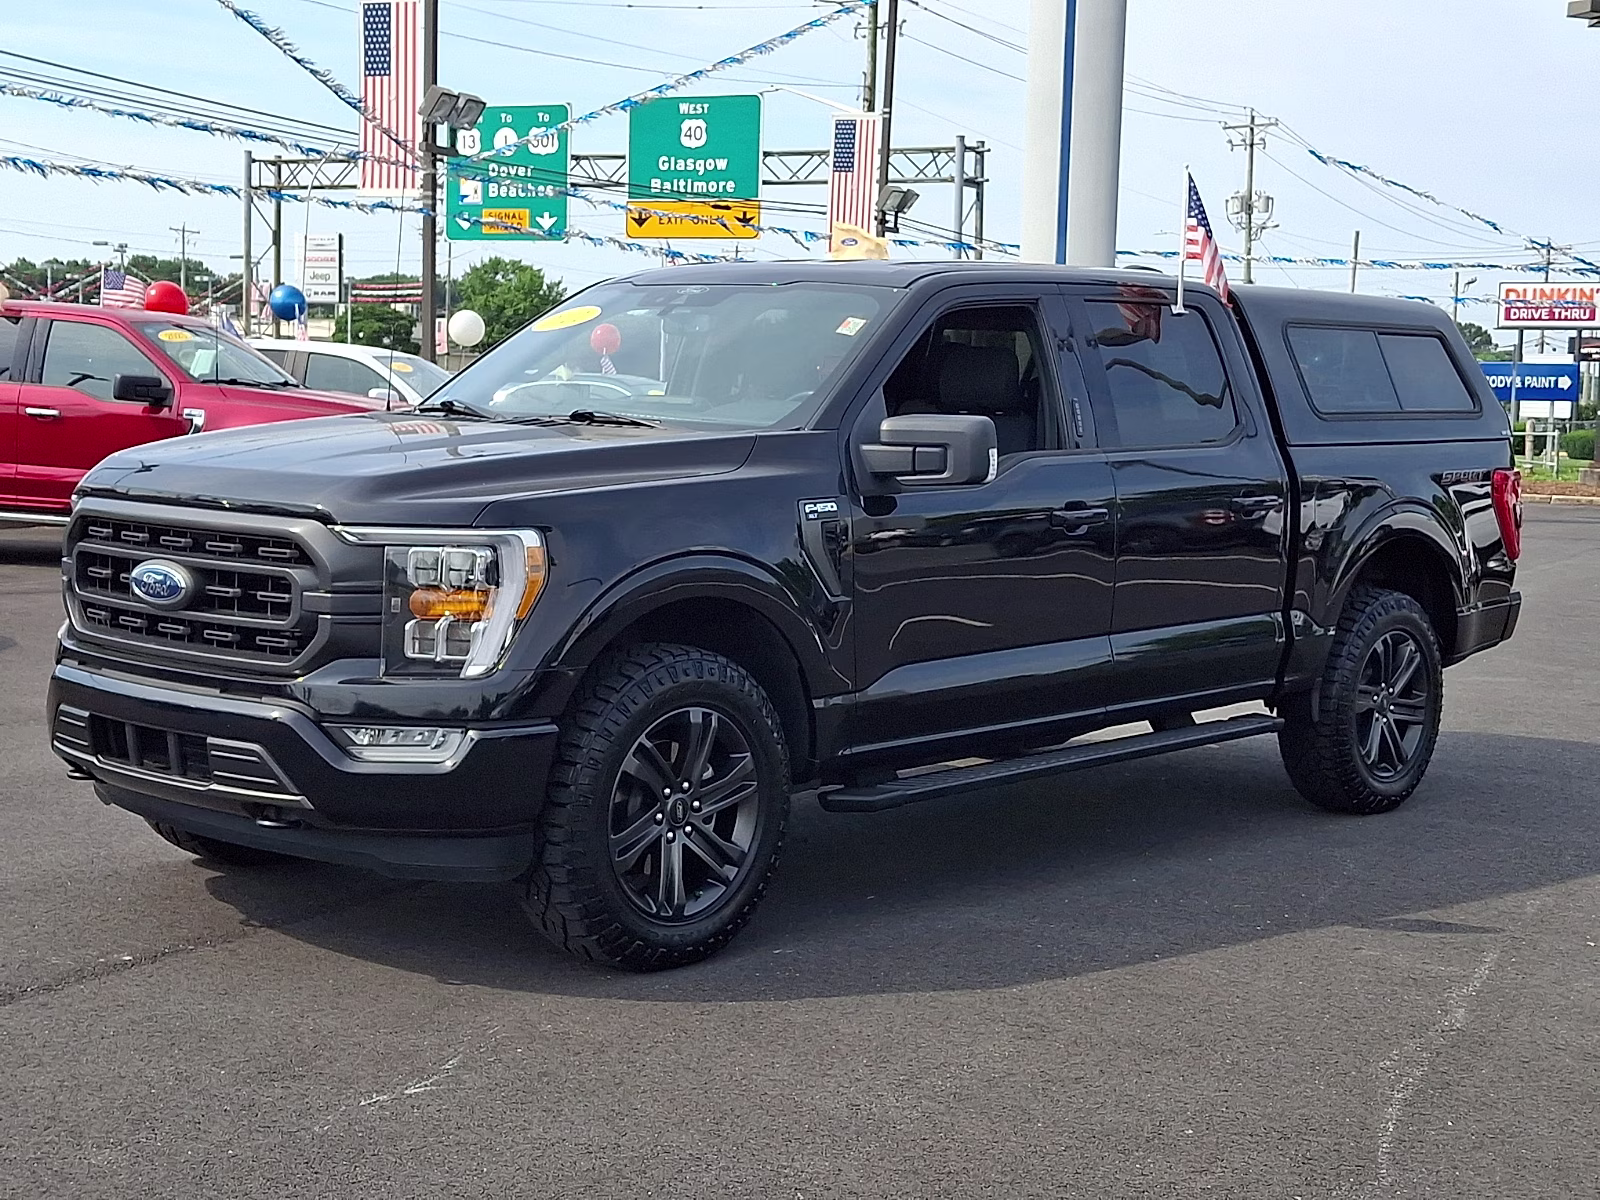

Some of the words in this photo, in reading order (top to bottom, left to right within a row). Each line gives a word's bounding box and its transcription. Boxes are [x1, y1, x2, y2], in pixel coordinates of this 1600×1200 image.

[678, 103, 710, 114] WEST
[501, 113, 513, 123] To
[538, 112, 550, 122] To
[683, 126, 703, 140] 40
[462, 135, 476, 149] 13
[488, 163, 534, 177] Dover
[658, 156, 728, 176] Glasgow
[488, 182, 554, 198] Beaches
[650, 178, 736, 193] Baltimore
[488, 211, 524, 221] SIGNAL
[310, 270, 331, 282] Jeep
[1510, 308, 1549, 319] DRIVE
[1553, 308, 1590, 320] THRU
[1486, 375, 1513, 388] ODY
[1515, 376, 1523, 388] &
[1524, 376, 1557, 389] PAINT
[141, 571, 174, 597] Ford
